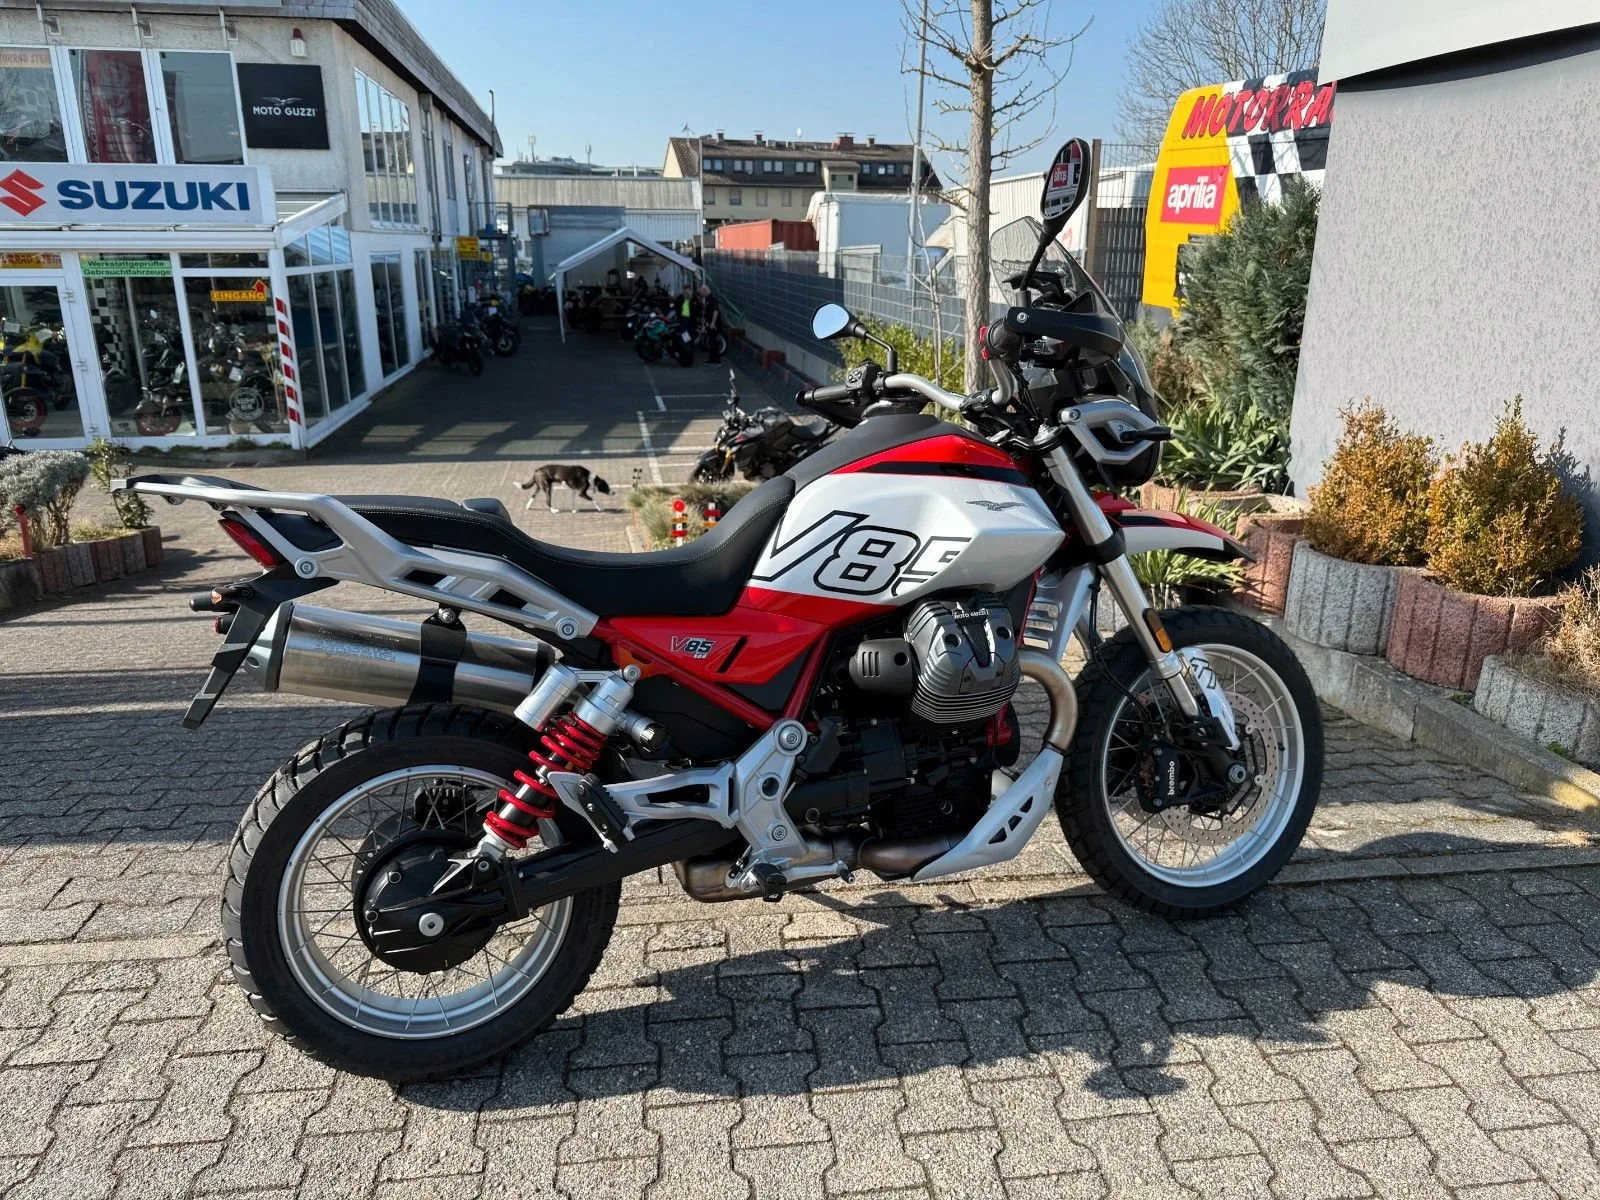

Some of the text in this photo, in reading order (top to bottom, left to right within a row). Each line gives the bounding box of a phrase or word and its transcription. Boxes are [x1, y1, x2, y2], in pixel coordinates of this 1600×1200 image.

[252, 106, 316, 117] MOTO GUZZI
[1182, 80, 1337, 139] MOTORRA
[56, 179, 251, 211] SUZUKI
[1167, 175, 1217, 215] aprilia
[83, 268, 172, 276] Gebrauchtfahrzeuge
[213, 291, 265, 300] EINGANG
[671, 636, 716, 653] V85
[1167, 760, 1176, 796] brembo
